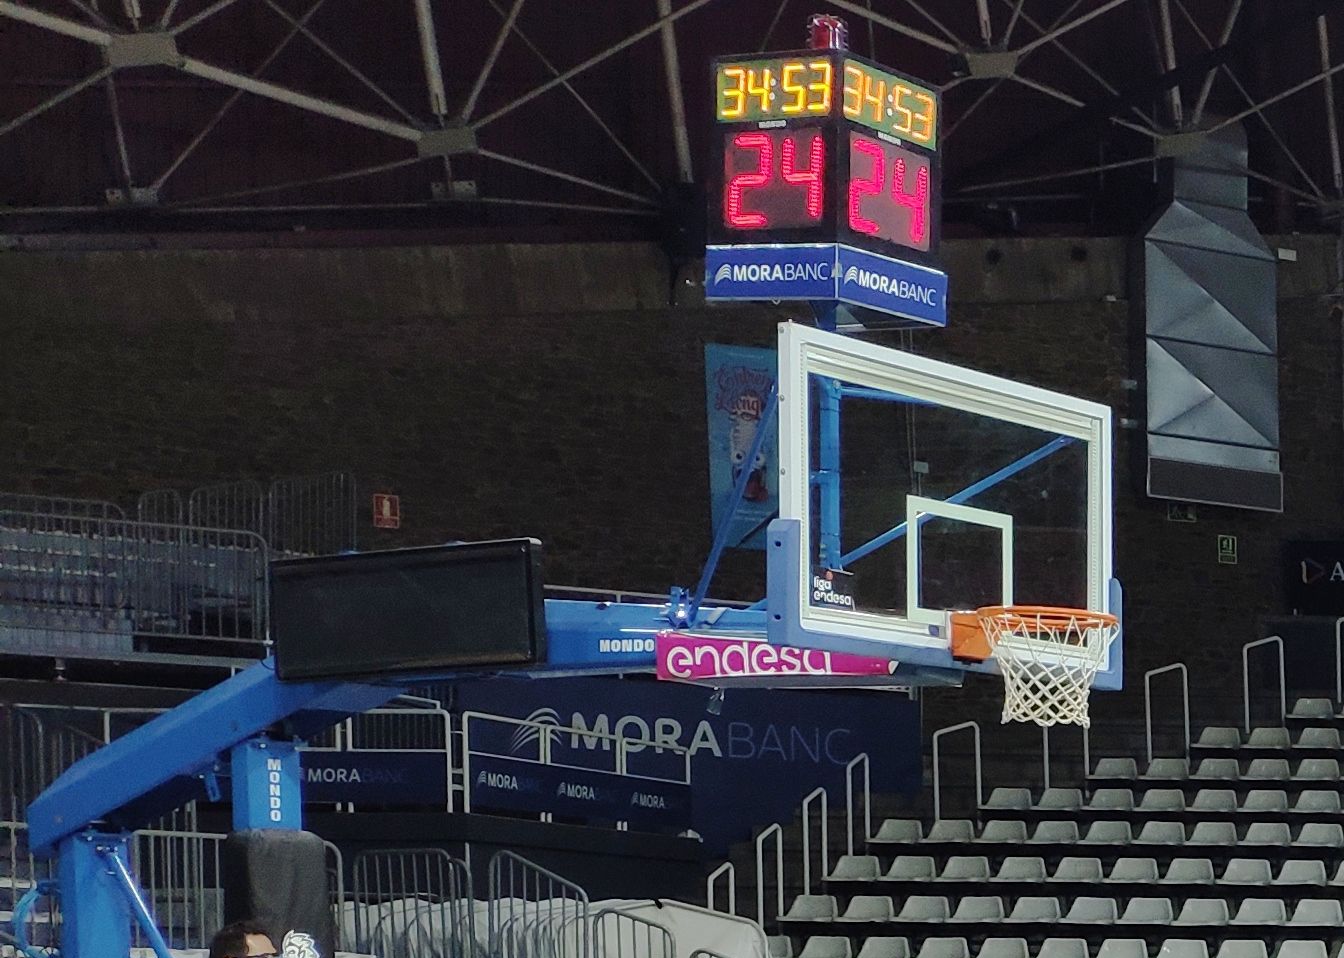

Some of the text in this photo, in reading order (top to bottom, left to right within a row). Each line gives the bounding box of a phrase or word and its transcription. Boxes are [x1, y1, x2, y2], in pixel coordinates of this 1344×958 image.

[721, 61, 832, 118] 34:53
[844, 66, 933, 143] 34:53
[726, 132, 824, 229] 24
[848, 138, 928, 243] 24
[733, 262, 829, 282] MORABANC
[858, 270, 937, 306] MORABANC
[814, 576, 831, 590] liga
[814, 589, 851, 605] endesa
[600, 639, 654, 653] MONDO
[666, 641, 832, 678] endesa
[571, 712, 852, 766] MORABANC
[267, 757, 281, 822] MONDO
